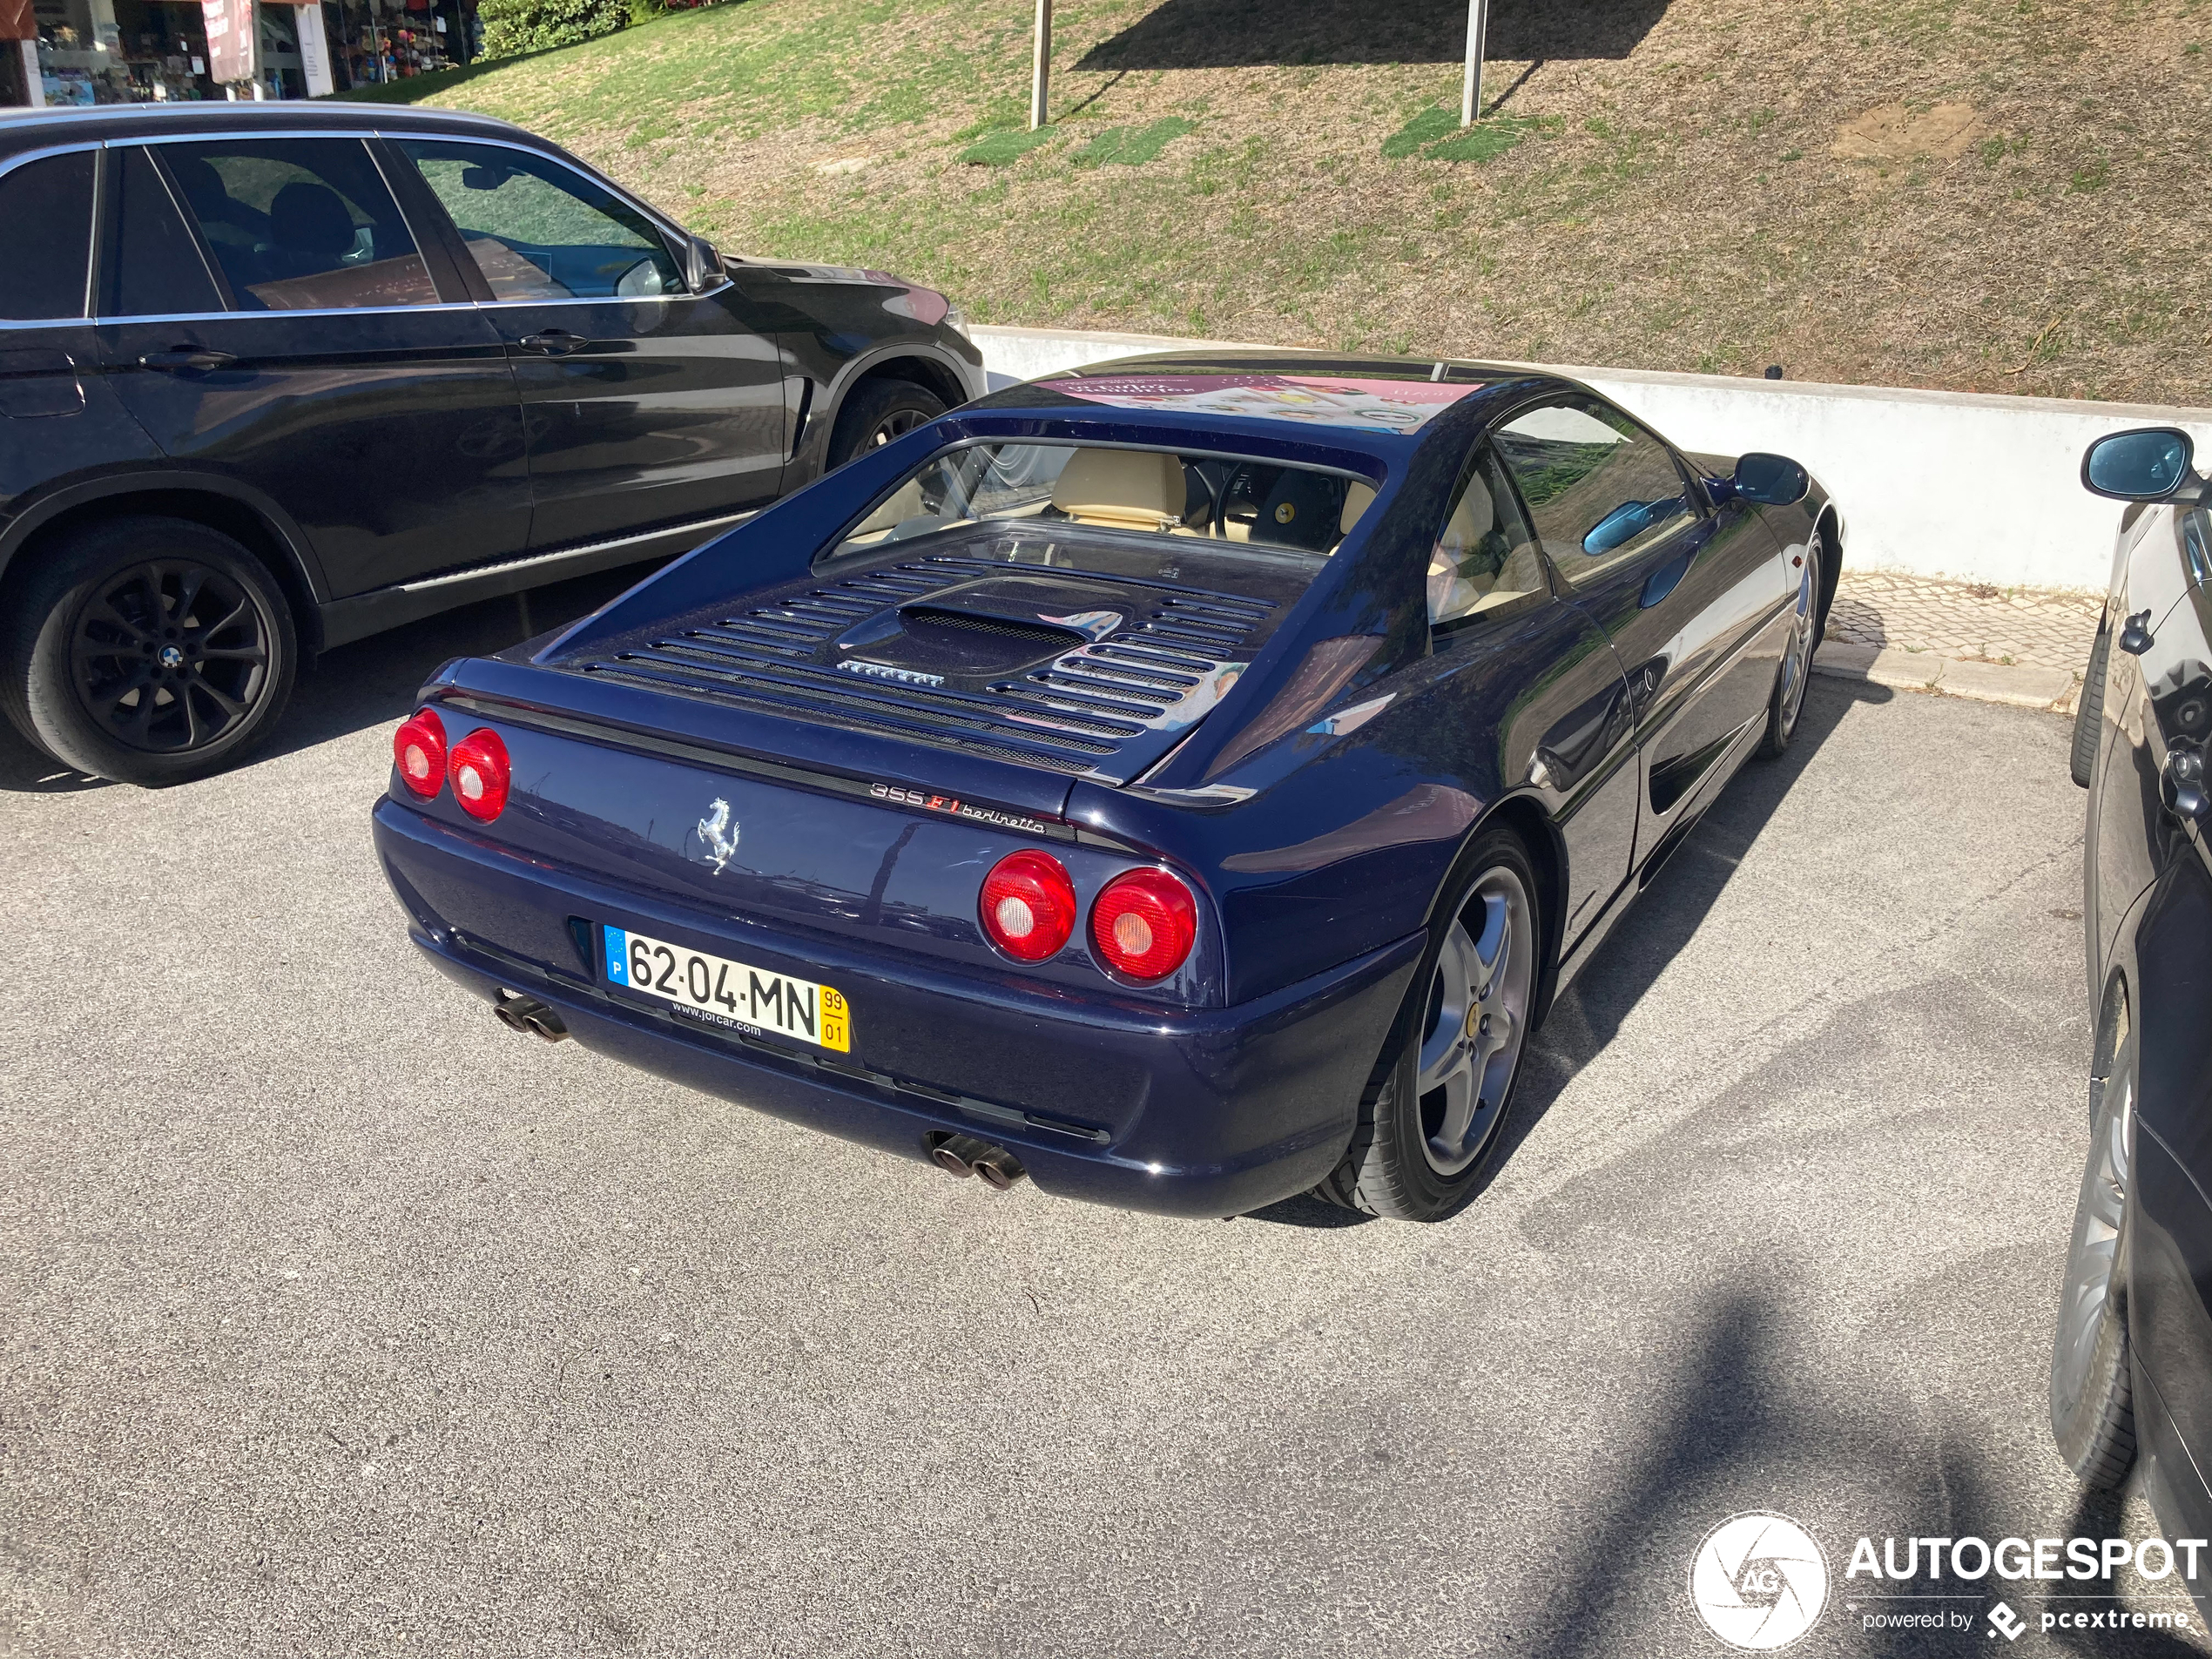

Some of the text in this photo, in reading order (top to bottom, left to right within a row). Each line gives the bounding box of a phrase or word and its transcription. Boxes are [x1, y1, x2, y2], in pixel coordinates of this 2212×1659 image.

[870, 782, 1046, 833] 355 F1 berlinetta
[613, 961, 622, 975] P
[824, 991, 843, 1011] 99
[825, 1024, 842, 1043] 01
